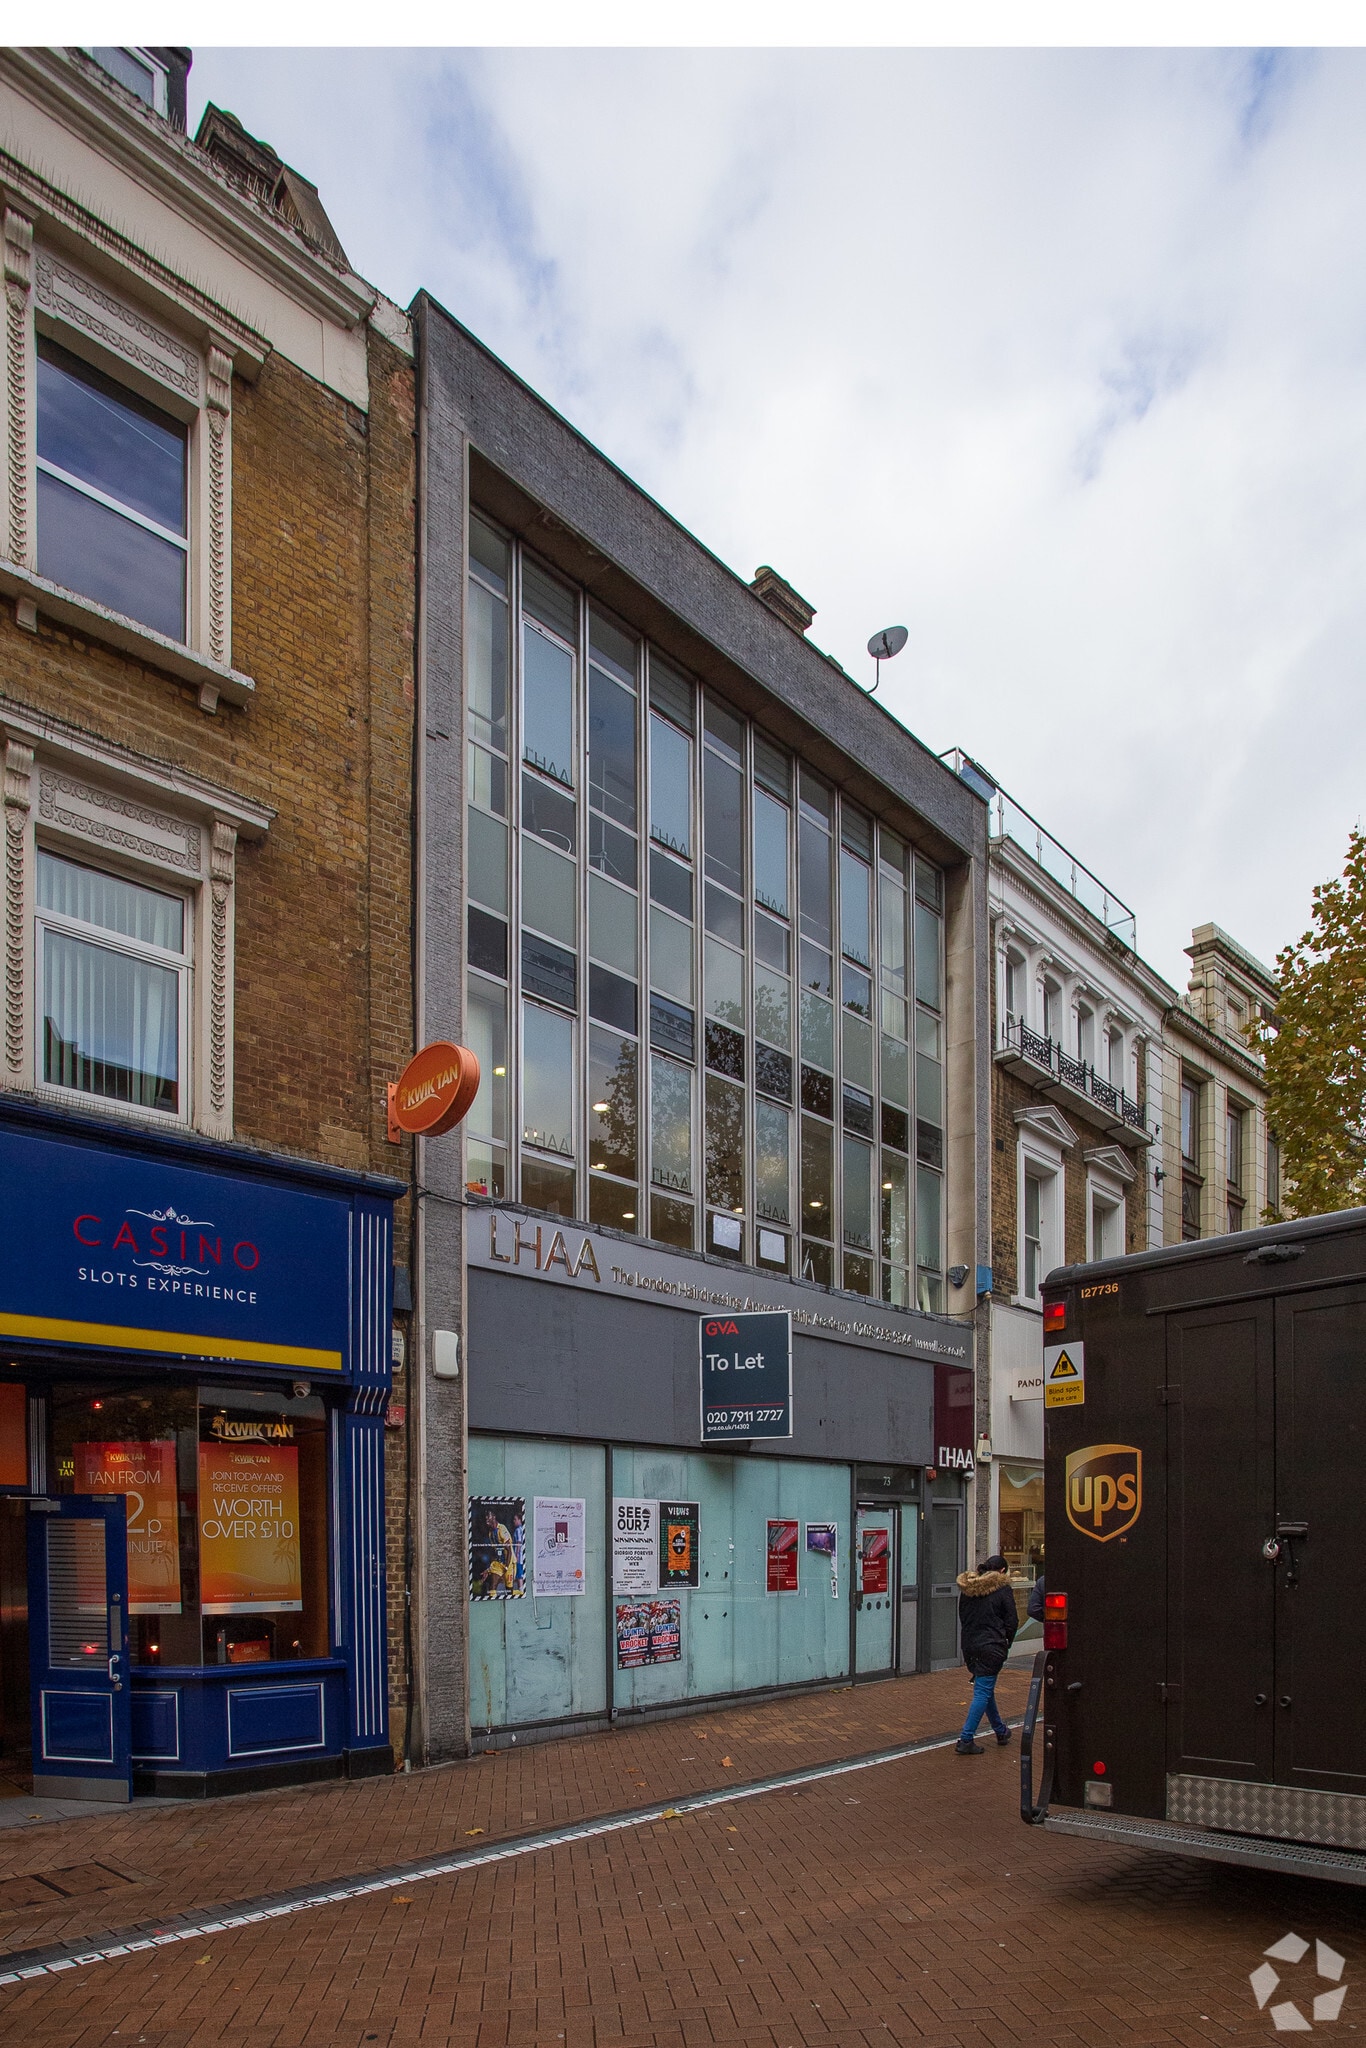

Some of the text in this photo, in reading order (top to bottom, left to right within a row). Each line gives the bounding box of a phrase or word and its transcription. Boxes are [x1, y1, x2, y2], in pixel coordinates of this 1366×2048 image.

[407, 1064, 458, 1107] KWIK TAN
[73, 1214, 260, 1271] CASINO
[489, 1214, 602, 1283] LHAA
[78, 1267, 257, 1304] SLOTS EXPERIENCE
[1081, 1283, 1119, 1299] 127736
[611, 1266, 634, 1286] The
[635, 1271, 677, 1295] London
[677, 1280, 743, 1312] Hairdressing
[812, 1312, 850, 1335] Academy
[705, 1321, 740, 1337] GVA
[706, 1352, 765, 1371] To Let
[1017, 1378, 1044, 1388] PAND
[1049, 1385, 1080, 1395] Blind spot
[706, 1409, 784, 1424] 020 7911 2727
[224, 1421, 294, 1438] KWIK TAN
[707, 1423, 750, 1432] gva.co.uk/14302
[110, 1453, 146, 1461] KWIK TAN
[234, 1455, 255, 1463] KWIK
[87, 1470, 161, 1485] TAN FROM
[210, 1471, 285, 1482] JOIN TODAY AND
[883, 1476, 891, 1486] 73
[212, 1483, 282, 1494] RECEIVE OFFERS
[1071, 1473, 1137, 1527] ups
[213, 1498, 283, 1518] WORTH
[618, 1505, 642, 1518] SEE
[202, 1520, 294, 1539] OVER £10
[617, 1518, 642, 1531] OUR
[127, 1541, 163, 1553] INUTE
